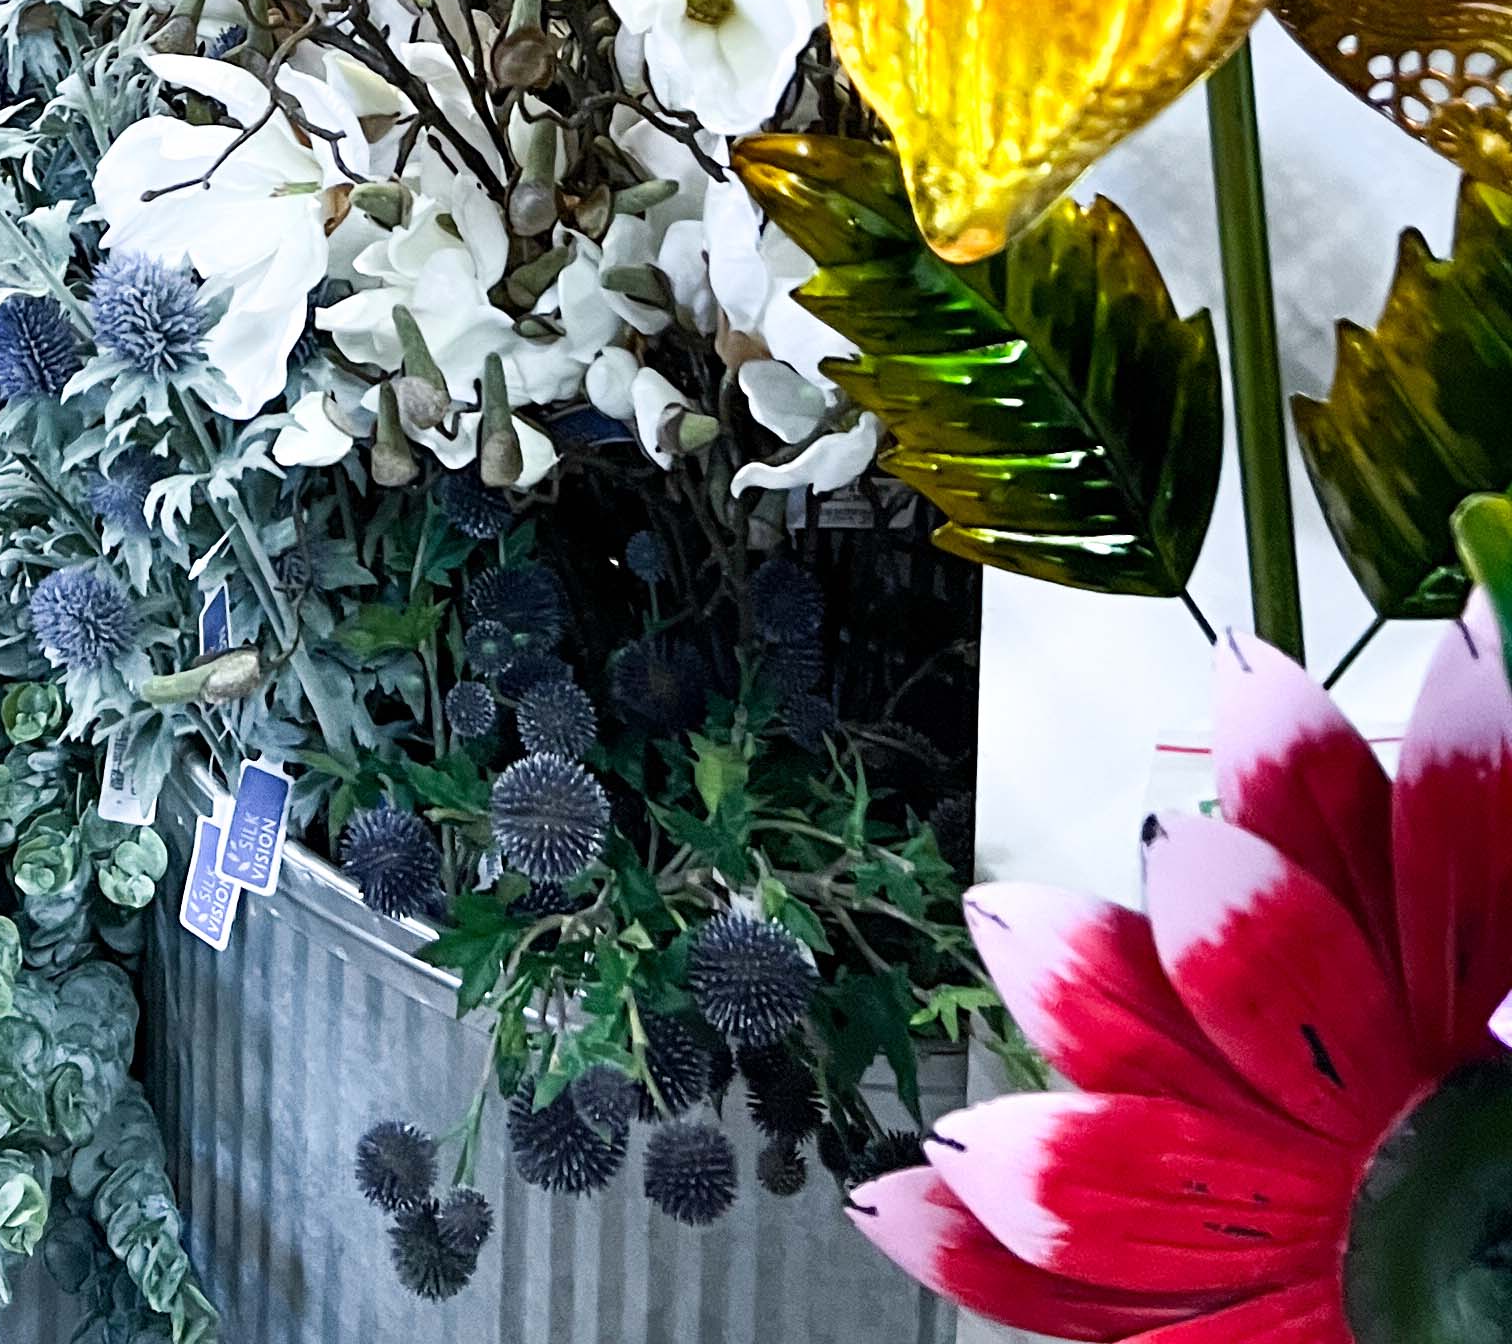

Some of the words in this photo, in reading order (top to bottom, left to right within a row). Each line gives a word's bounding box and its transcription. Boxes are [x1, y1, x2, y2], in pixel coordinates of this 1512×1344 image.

[238, 813, 261, 850] SILK
[251, 817, 277, 880] VISION
[198, 866, 218, 903] SILK
